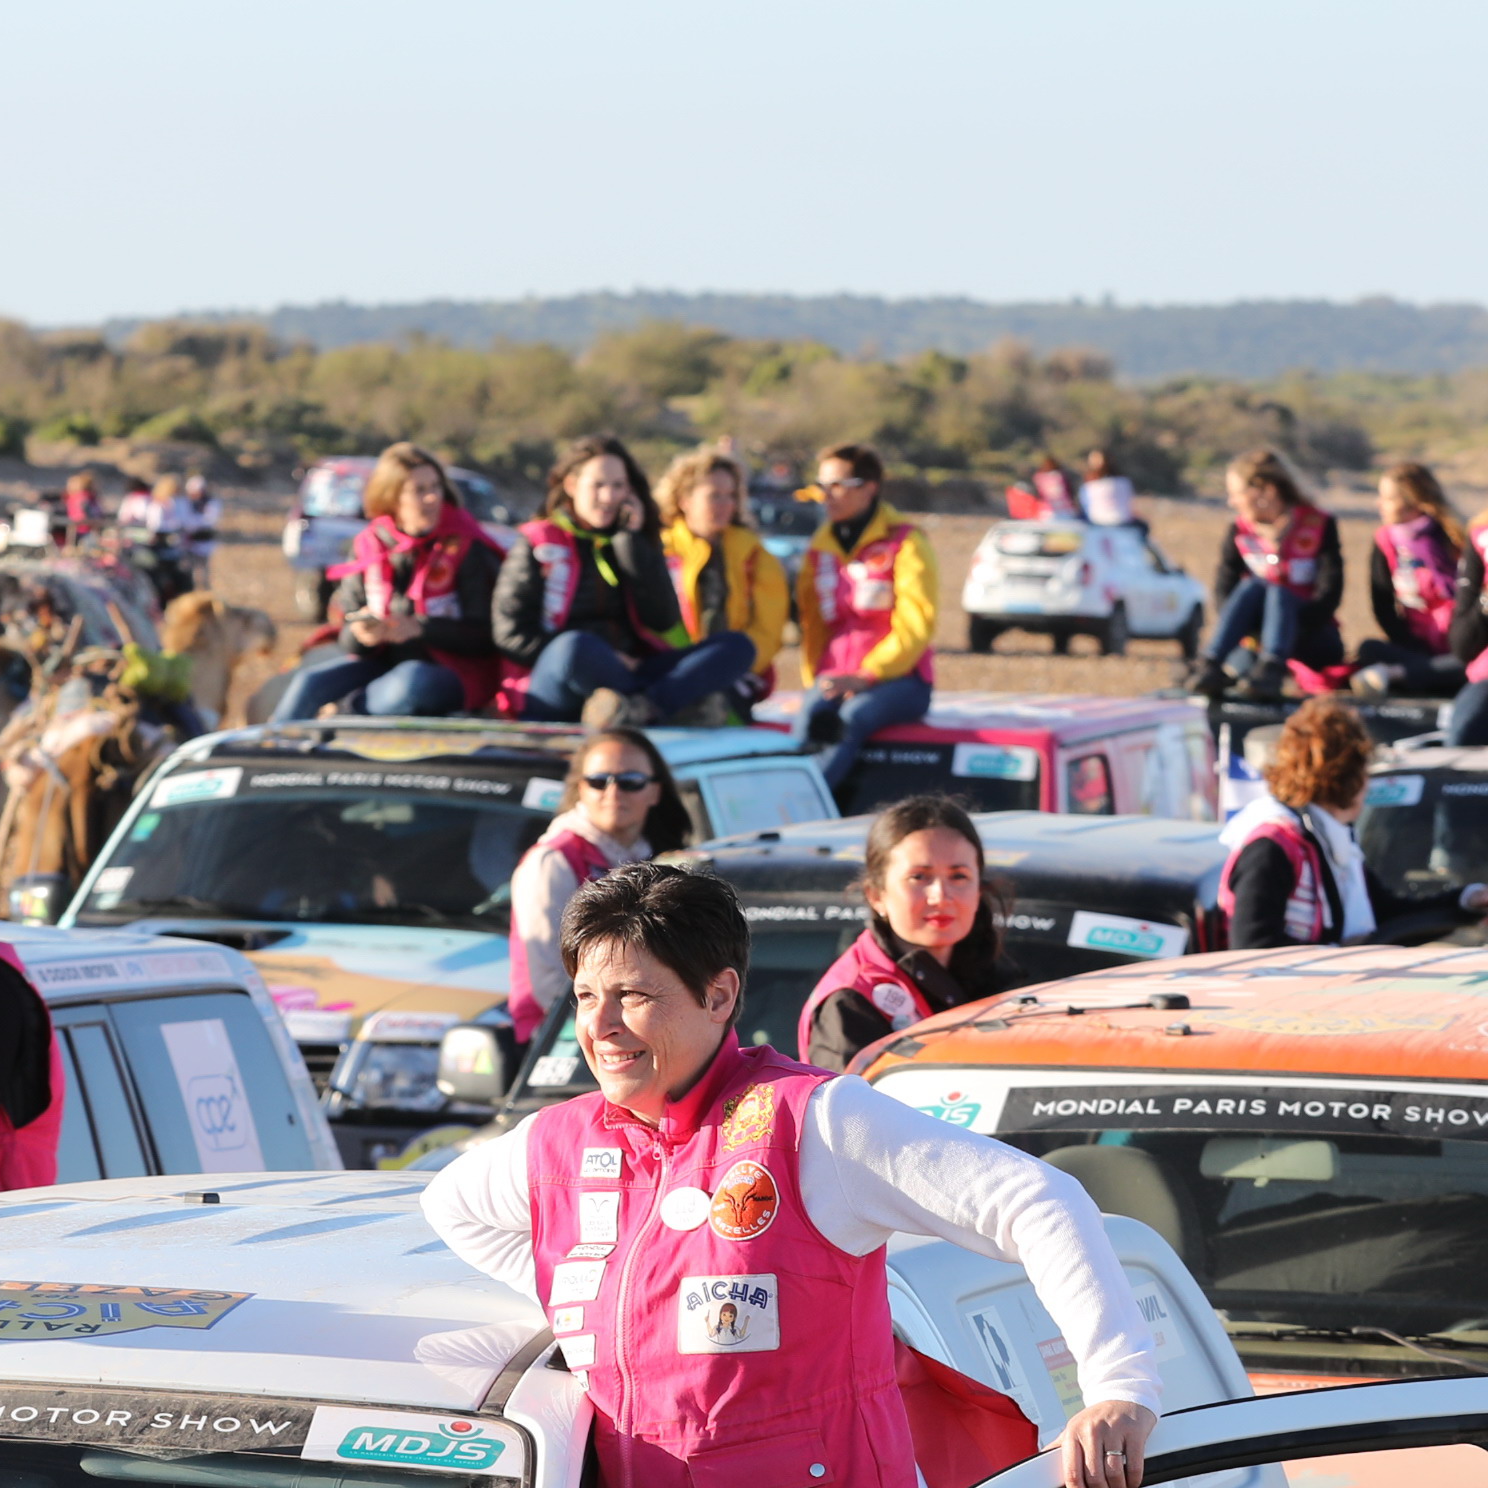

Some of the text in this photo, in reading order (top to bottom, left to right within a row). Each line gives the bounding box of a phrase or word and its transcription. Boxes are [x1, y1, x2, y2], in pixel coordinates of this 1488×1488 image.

[746, 906, 869, 922] ONDIAL PAR
[1032, 1097, 1163, 1118] MONDIAL
[1173, 1097, 1268, 1119] PARIS
[1278, 1101, 1392, 1123] MOTOR
[585, 1152, 617, 1167] ATOL
[150, 1410, 293, 1437] SHOW
[352, 1432, 492, 1461] MDJS
